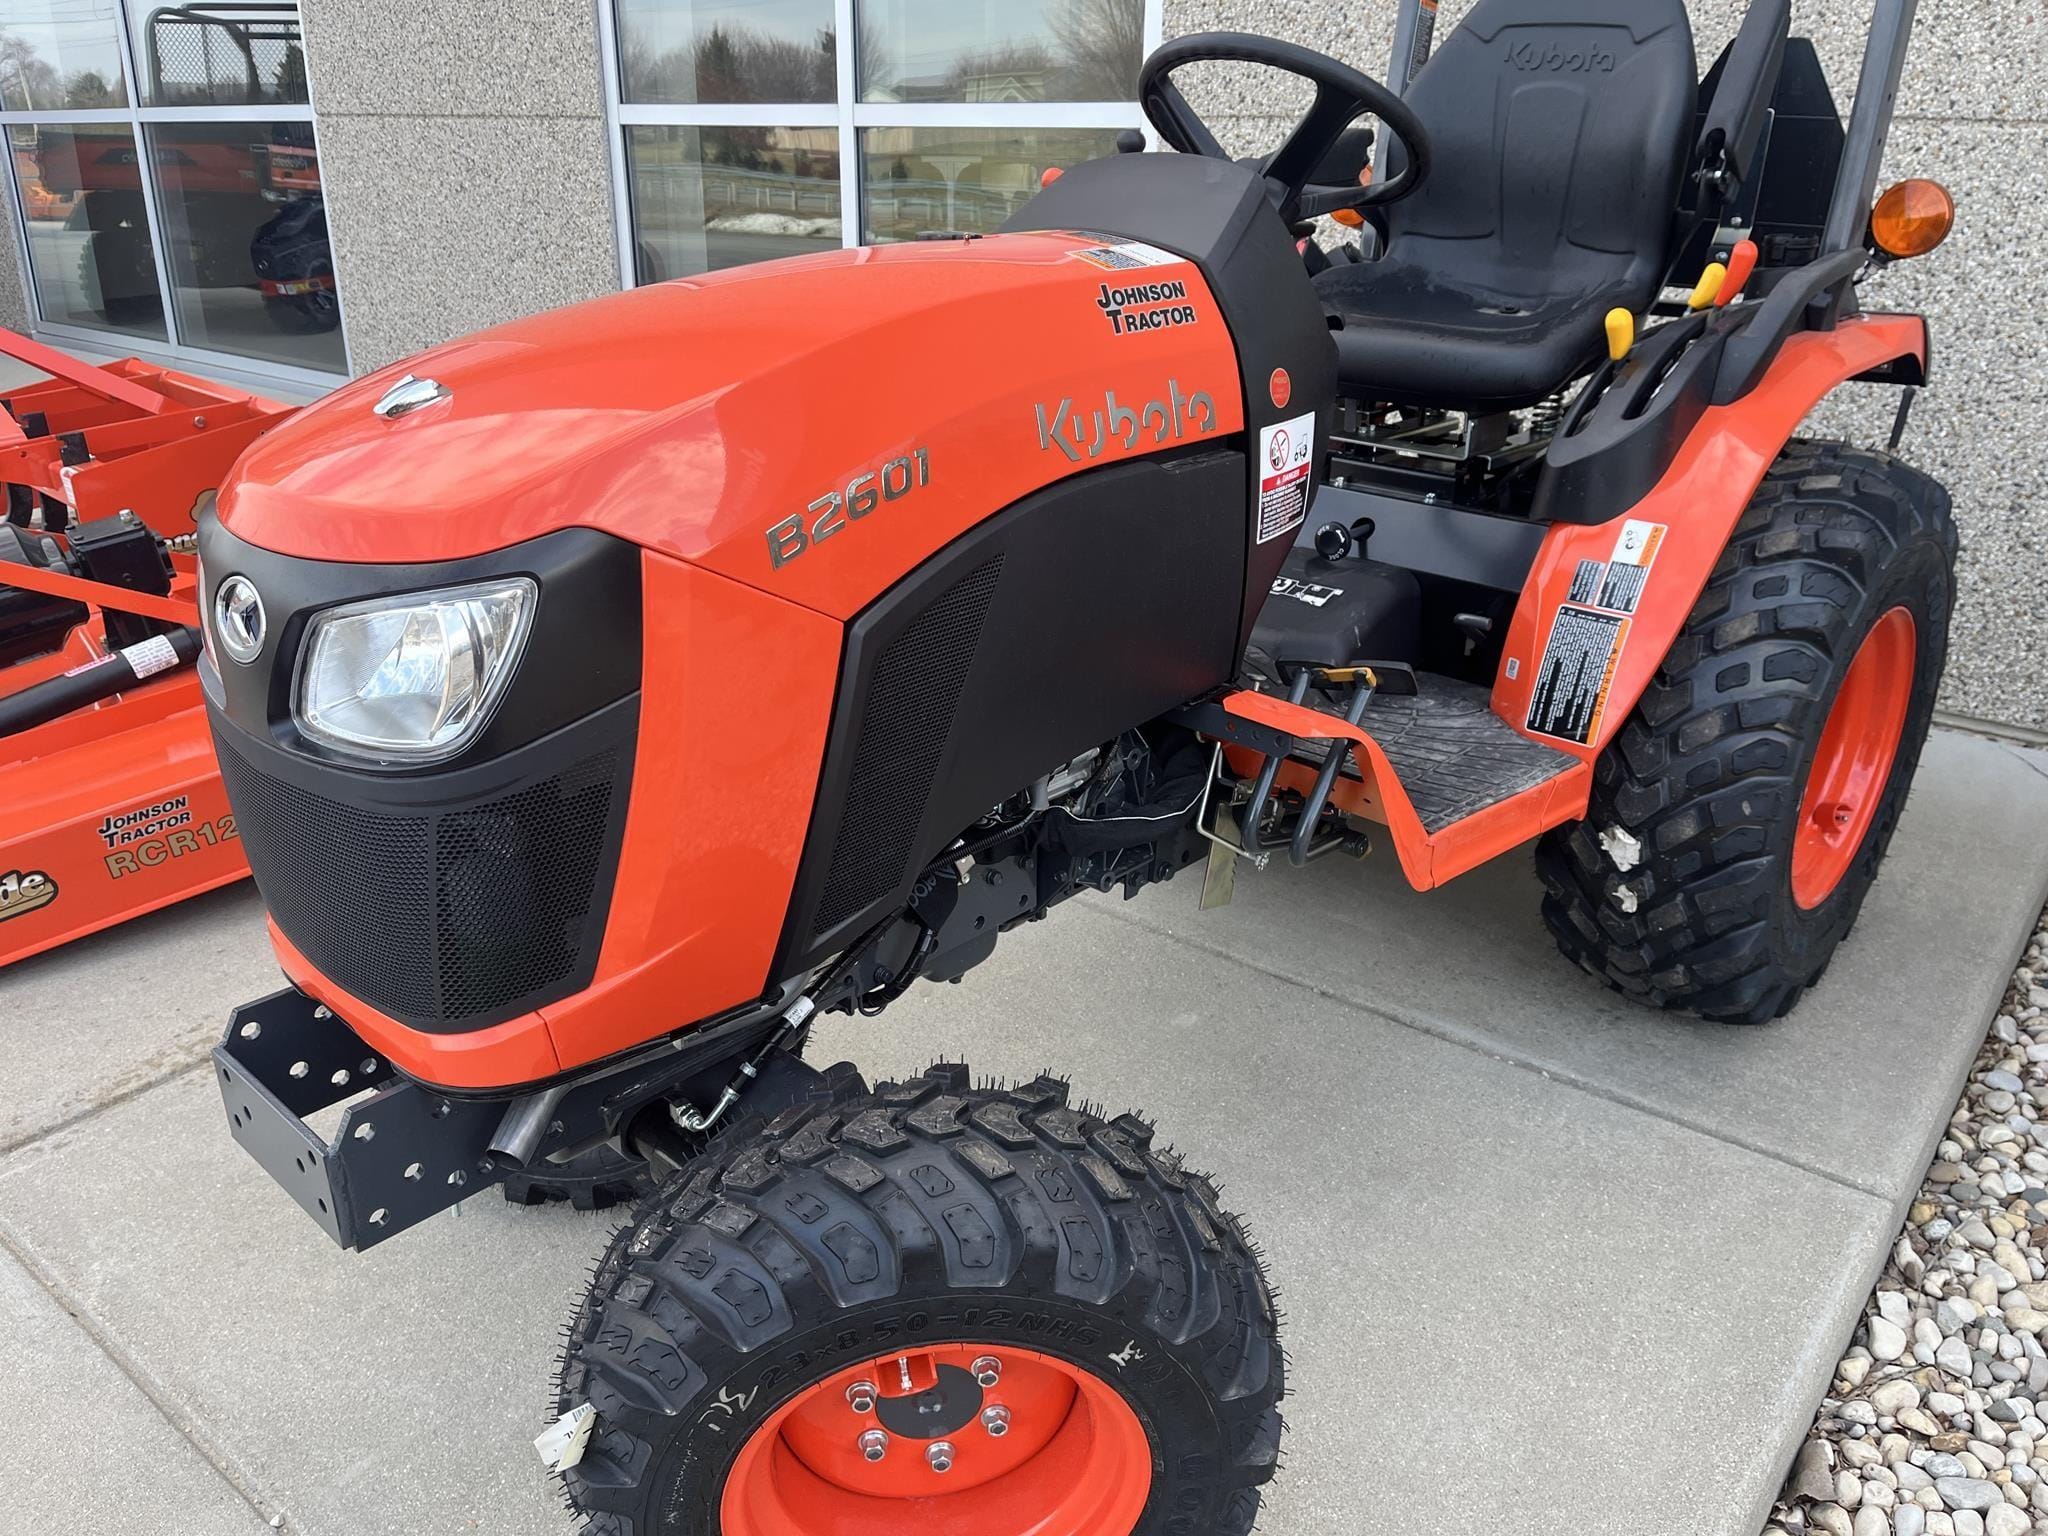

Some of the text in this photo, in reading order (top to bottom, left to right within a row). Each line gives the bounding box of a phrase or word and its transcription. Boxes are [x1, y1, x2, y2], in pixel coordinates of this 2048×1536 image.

[1504, 41, 1616, 73] Kubota
[1097, 281, 1186, 309] JOHNSON
[1106, 305, 1196, 334] TRACTOR
[1033, 379, 1218, 462] Kubota
[765, 447, 930, 571] B2601
[1595, 658, 1617, 717] WARNING
[98, 796, 187, 834] JOHNSON
[103, 811, 191, 848] TRACTOR
